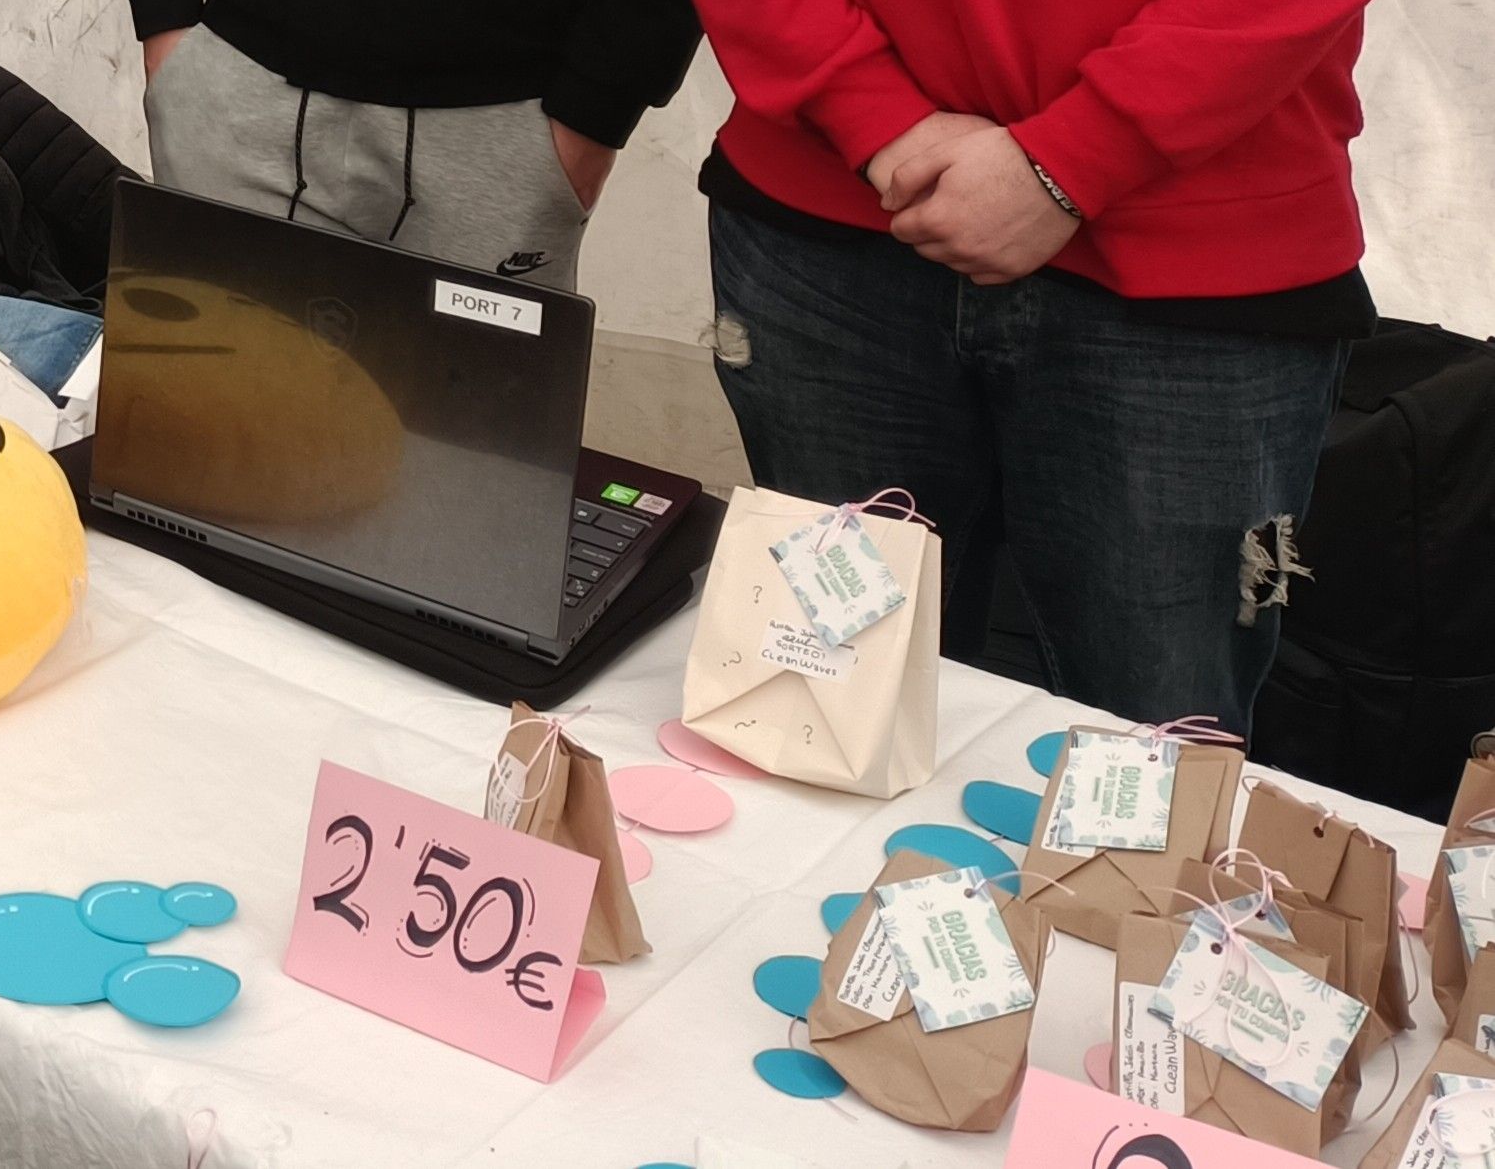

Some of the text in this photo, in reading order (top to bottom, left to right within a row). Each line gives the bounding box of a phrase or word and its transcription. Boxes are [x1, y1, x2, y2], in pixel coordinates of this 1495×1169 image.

[452, 292, 522, 321] PORT 7
[826, 544, 867, 598] GRACIAS
[1115, 766, 1141, 819] GRACIAS
[942, 910, 988, 981] GRACIAS
[1221, 970, 1307, 1032] GRACIAS
[1234, 1003, 1249, 1020] TU
